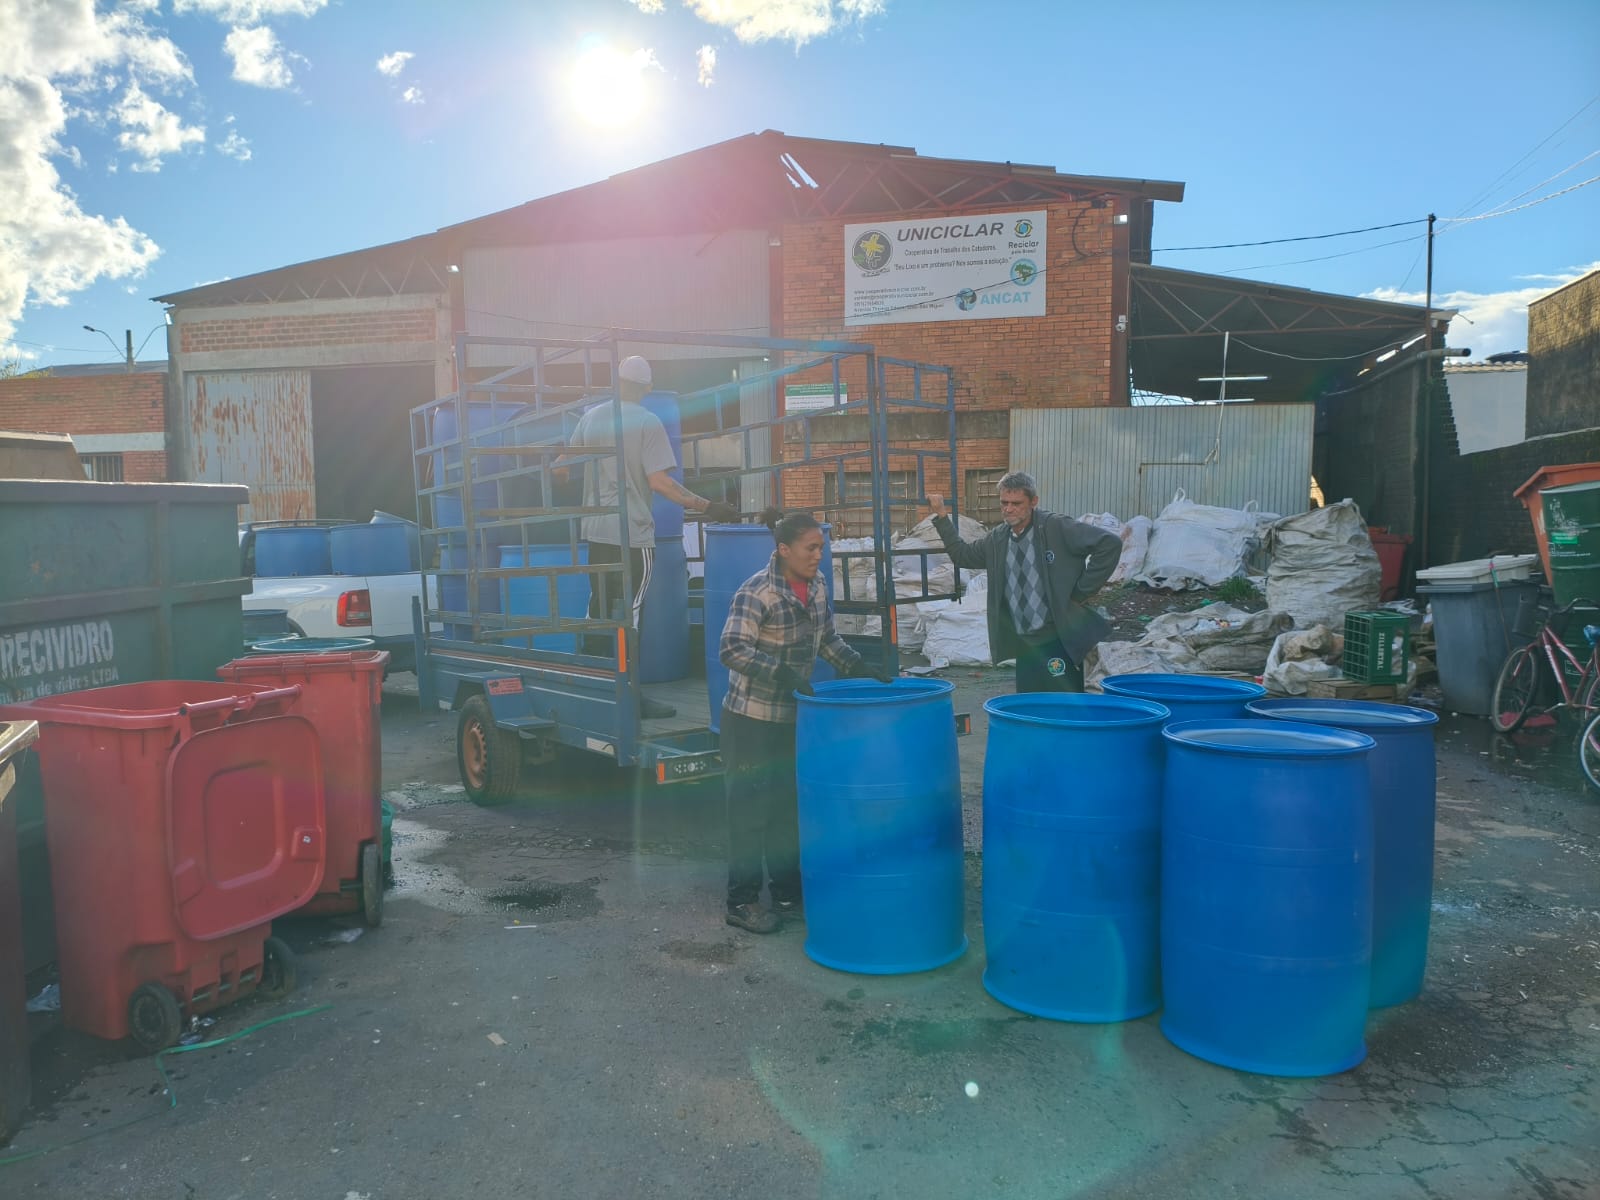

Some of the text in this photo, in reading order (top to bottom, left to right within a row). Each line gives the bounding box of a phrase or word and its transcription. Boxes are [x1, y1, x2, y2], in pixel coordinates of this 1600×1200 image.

[897, 222, 1004, 242] UNICICLAR
[905, 248, 932, 256] Cooperativa
[1008, 240, 1039, 249] Reciclar
[980, 291, 1031, 305] ANCAT
[0, 620, 114, 680] RECIVIDRO
[37, 680, 51, 697] de
